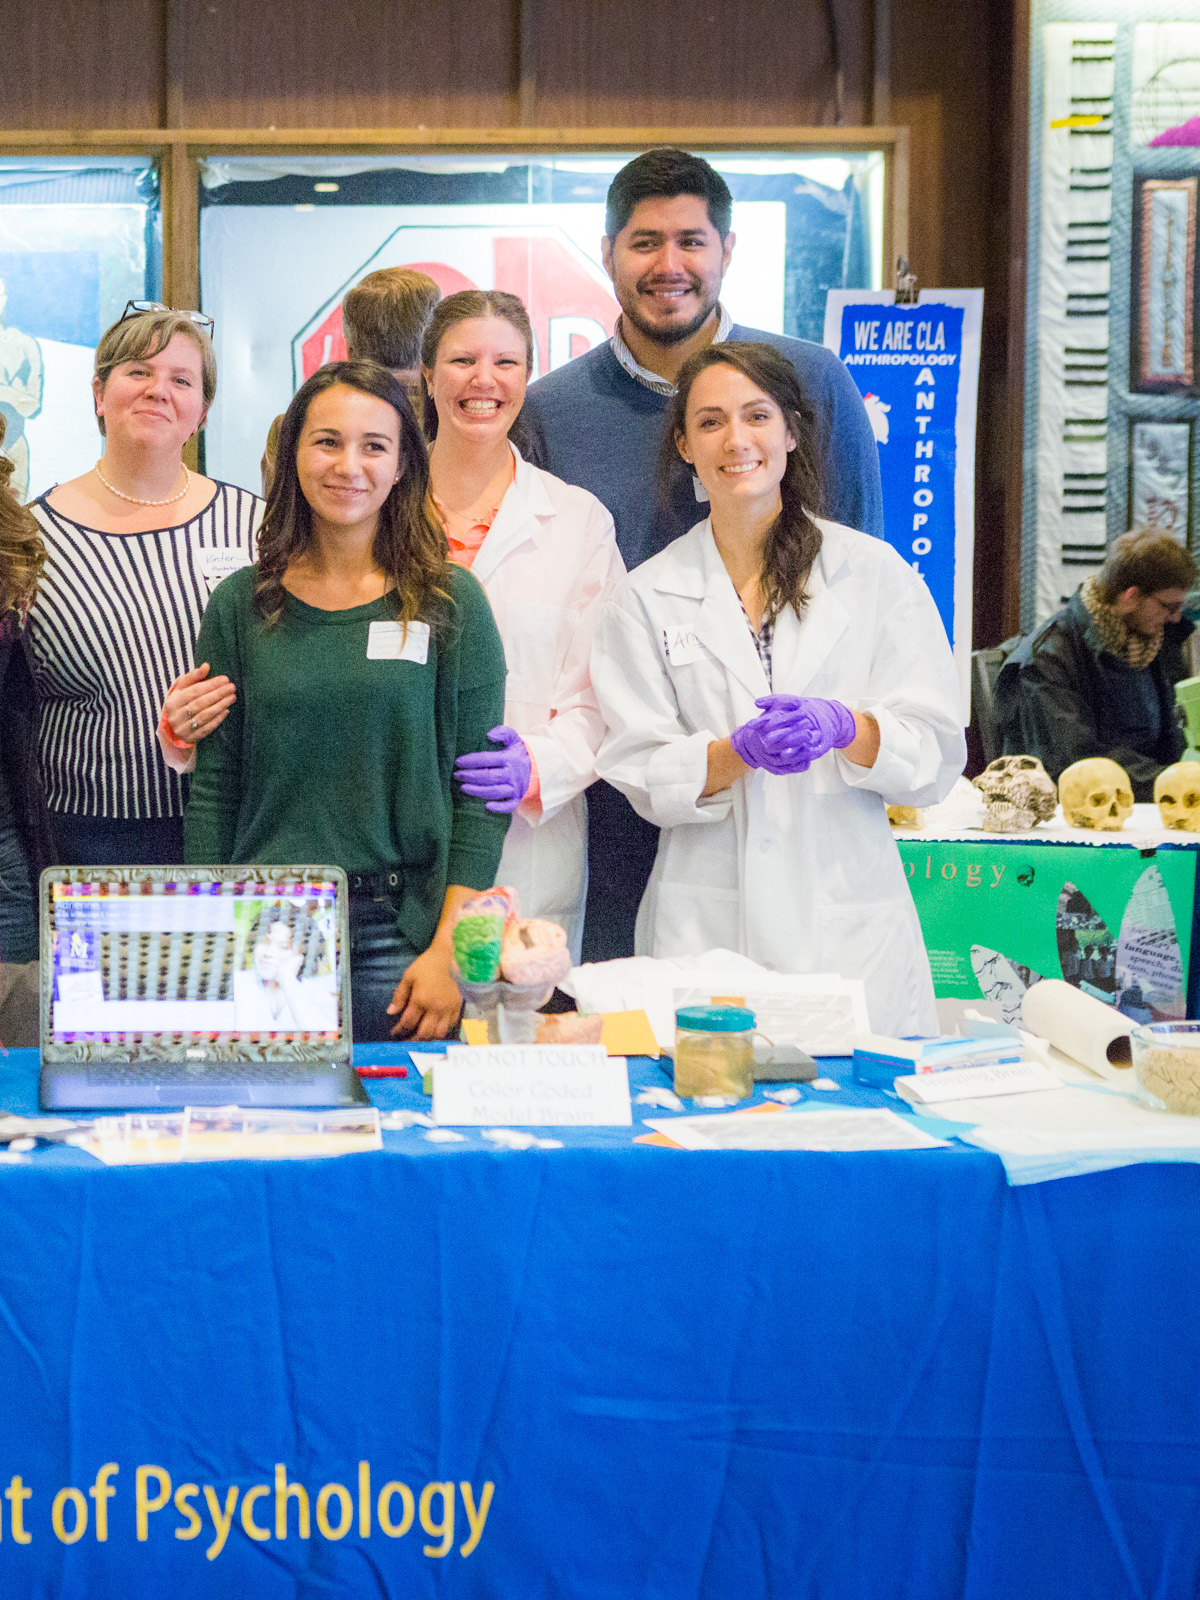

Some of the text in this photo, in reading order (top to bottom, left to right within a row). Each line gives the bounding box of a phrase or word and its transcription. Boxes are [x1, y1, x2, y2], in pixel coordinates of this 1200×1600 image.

[854, 320, 946, 351] WE ARE CLA
[844, 353, 958, 366] ANTHROPOLOGY
[453, 1050, 607, 1067] DO NOT TOUCH
[468, 1080, 593, 1099] Color Coded
[472, 1106, 594, 1123] Model Brain
[51, 1462, 120, 1545] of
[135, 1460, 496, 1562] Psychology
